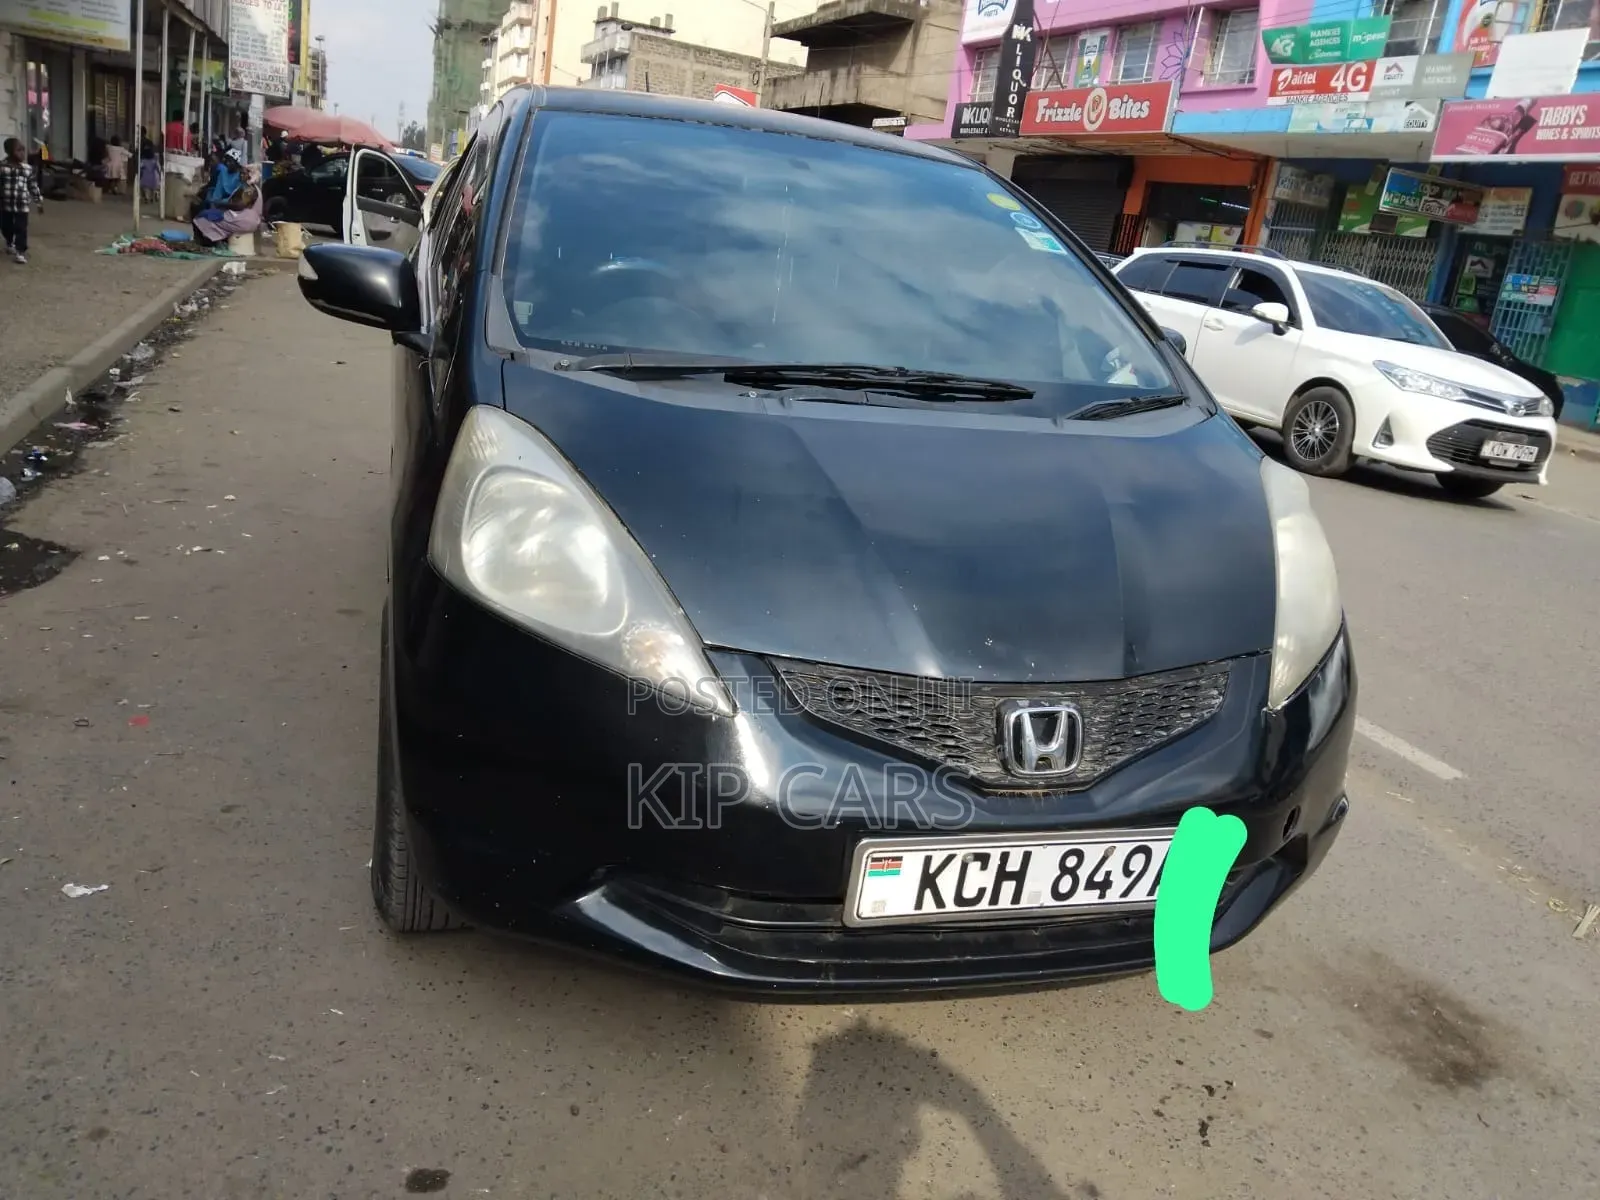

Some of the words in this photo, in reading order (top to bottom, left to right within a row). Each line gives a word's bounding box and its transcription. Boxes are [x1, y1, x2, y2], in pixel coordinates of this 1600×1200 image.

[1291, 71, 1317, 85] airtel
[1330, 62, 1368, 93] 4G
[1035, 97, 1083, 123] Frizzle
[1108, 94, 1150, 120] Bites
[1539, 104, 1588, 127] TABBYS
[1404, 119, 1428, 129] EQUITY
[913, 849, 1033, 912] KCH
[1049, 843, 1164, 902] 849
